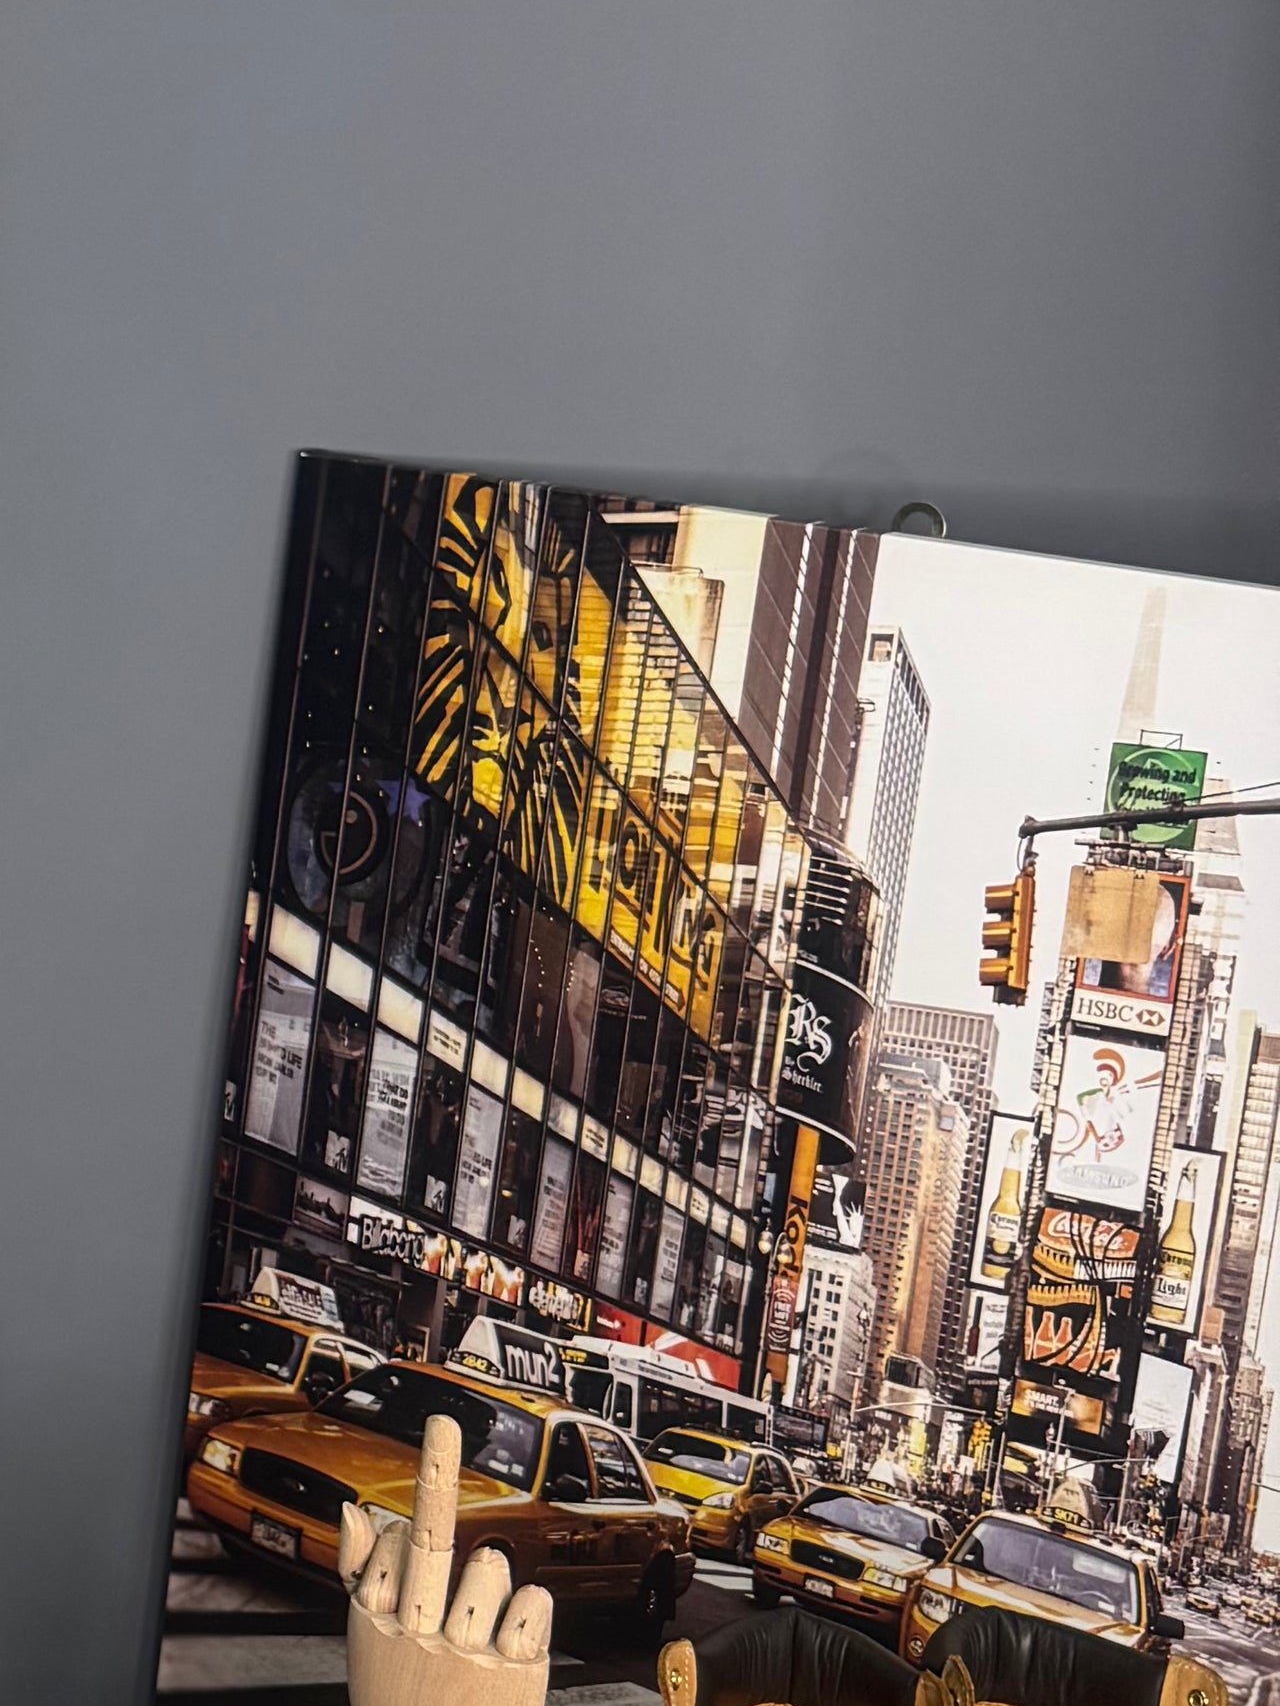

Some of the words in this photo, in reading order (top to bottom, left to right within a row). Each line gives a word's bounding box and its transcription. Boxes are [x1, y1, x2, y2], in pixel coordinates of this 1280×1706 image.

[1172, 768, 1197, 784] and
[1077, 998, 1134, 1022] HSBC
[1157, 1277, 1187, 1296] Light
[504, 1341, 560, 1387] mun2
